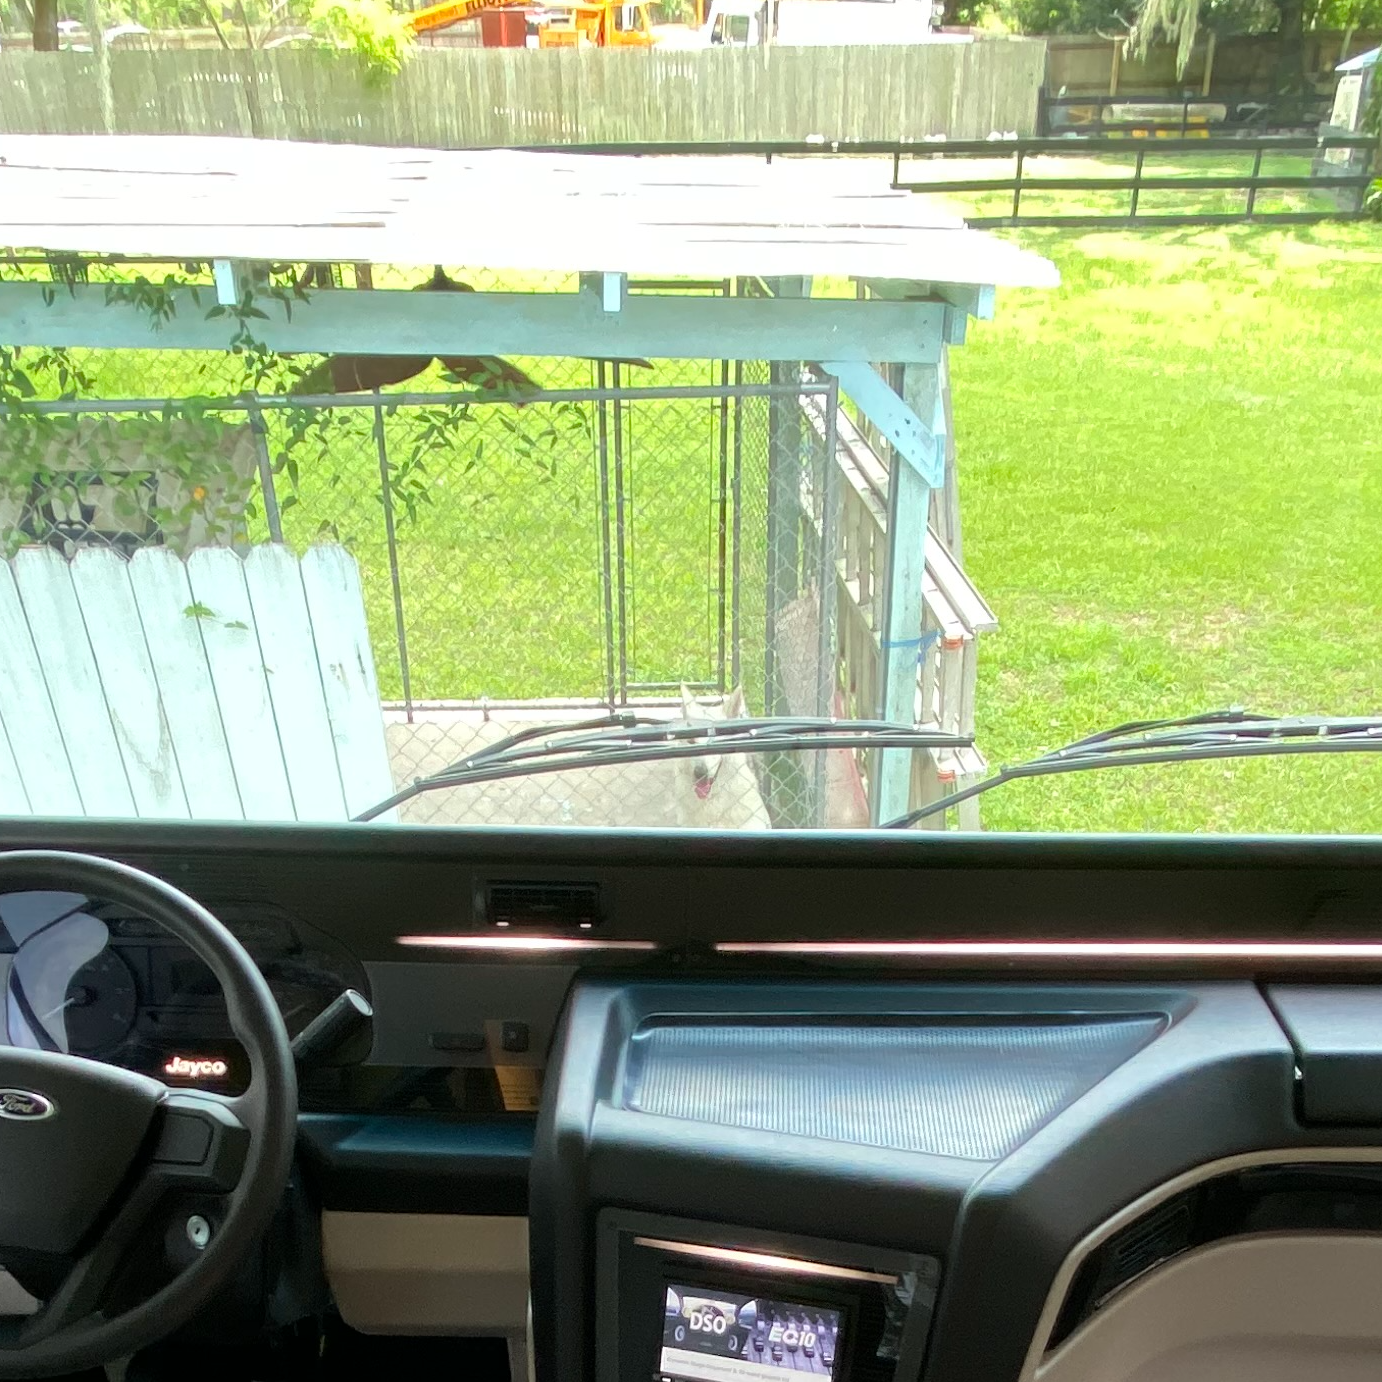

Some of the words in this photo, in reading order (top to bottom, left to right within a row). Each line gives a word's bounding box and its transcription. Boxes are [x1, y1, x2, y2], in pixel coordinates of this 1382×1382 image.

[165, 1056, 227, 1078] Jayco
[689, 1312, 727, 1335] DSO
[769, 1326, 817, 1348] EQ10
